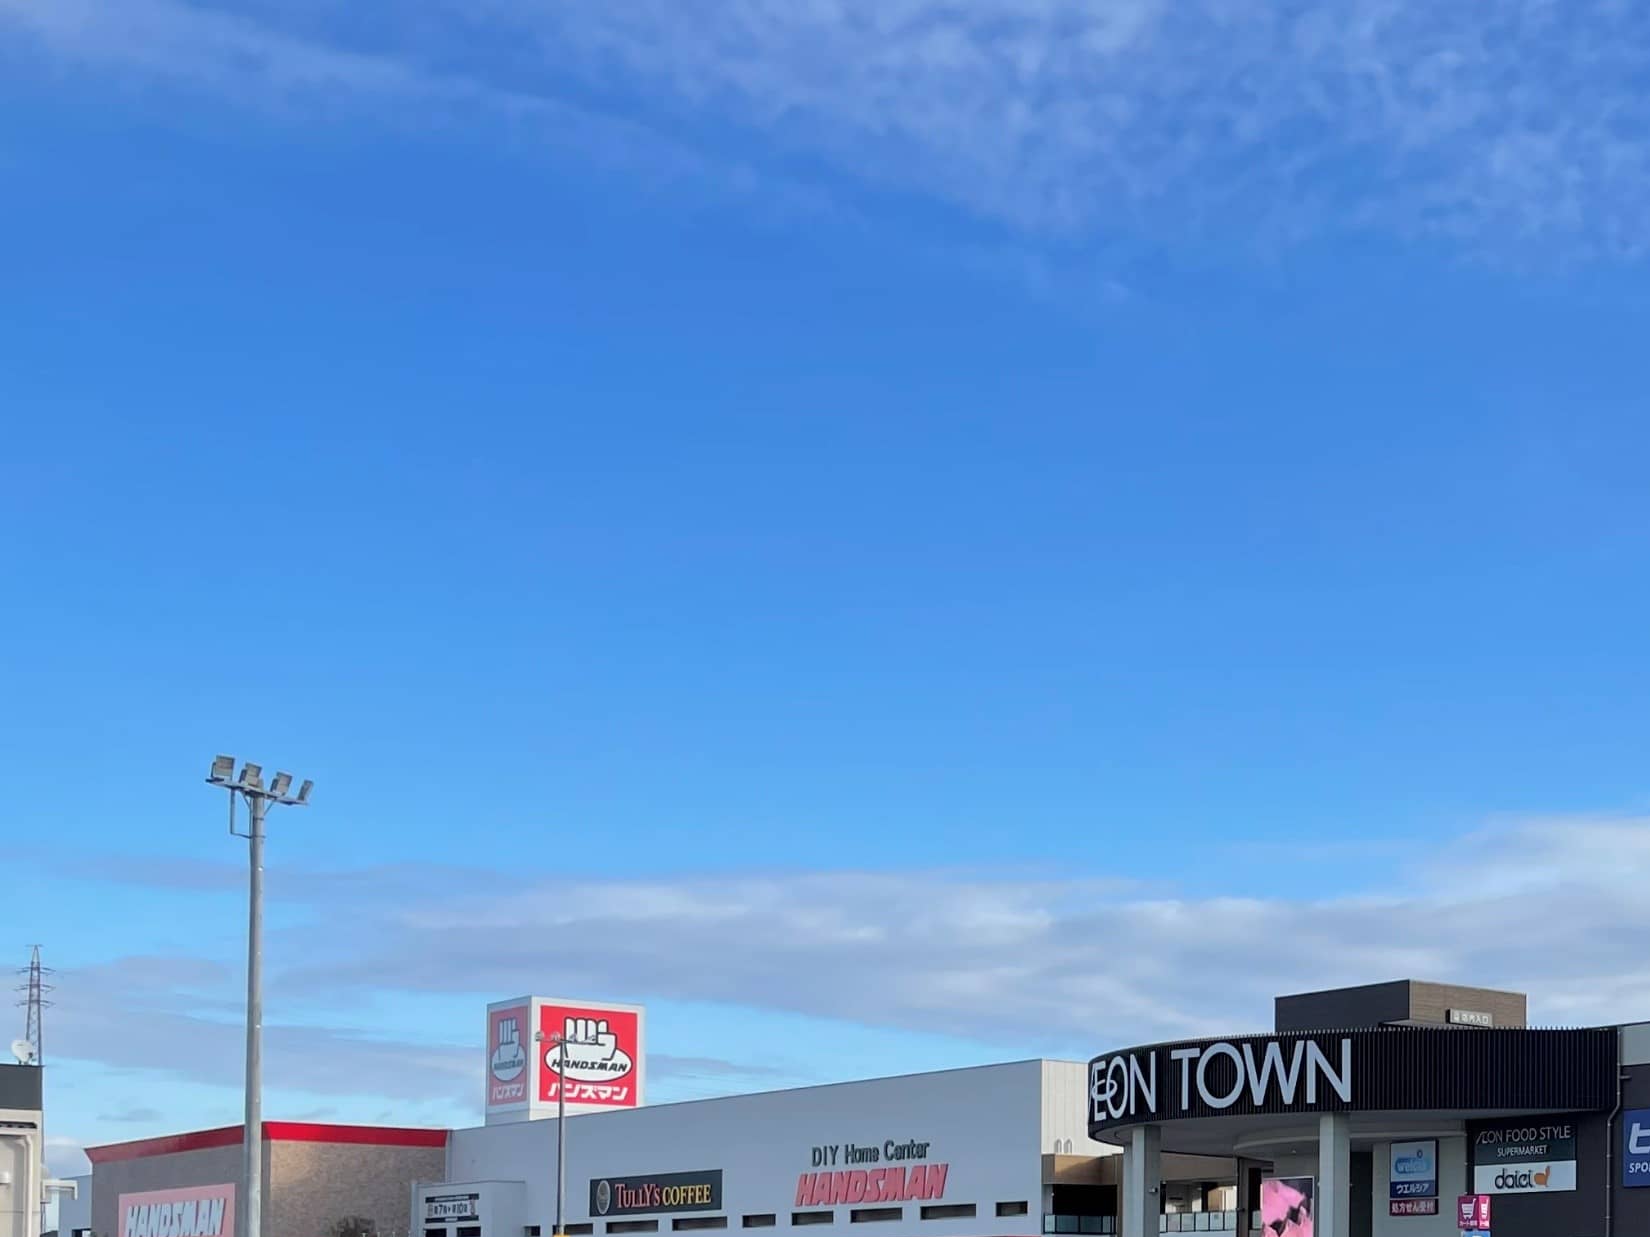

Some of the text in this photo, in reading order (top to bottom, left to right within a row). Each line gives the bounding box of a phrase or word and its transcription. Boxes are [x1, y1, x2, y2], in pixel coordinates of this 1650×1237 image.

[551, 1058, 628, 1073] HANDSMAN
[1171, 1038, 1352, 1110] TOWN
[1505, 1127, 1537, 1143] FOOD
[1540, 1125, 1571, 1140] STYLE
[812, 1138, 930, 1167] DIY Home Center
[1497, 1145, 1549, 1157] SUPERMARKET
[795, 1163, 949, 1206] HANDSMAN
[1495, 1167, 1534, 1189] daiei
[662, 1184, 711, 1205] COFFEE
